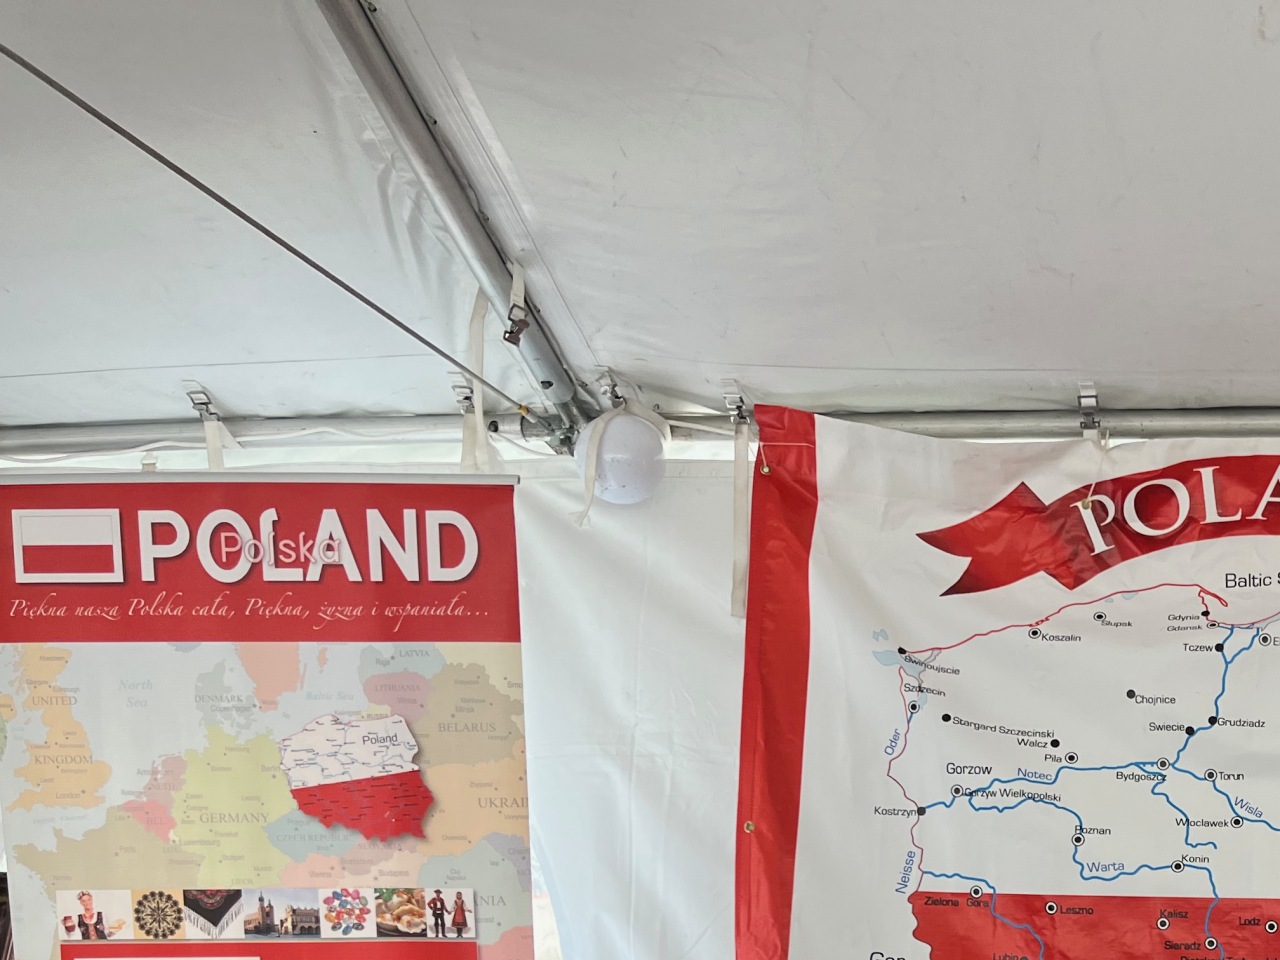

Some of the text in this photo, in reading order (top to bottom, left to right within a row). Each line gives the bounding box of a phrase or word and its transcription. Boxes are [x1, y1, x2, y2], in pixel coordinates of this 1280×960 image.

[138, 508, 480, 583] POLAND
[1225, 573, 1272, 588] Baltic
[1168, 614, 1200, 622] Gdynia
[1042, 633, 1081, 643] Koszalin
[1183, 643, 1213, 653] Tczew
[118, 678, 153, 693] North
[32, 695, 78, 707] UNITED
[1135, 694, 1176, 706] Chojnice
[438, 722, 496, 734] BELARUS
[952, 716, 999, 734] Stargard
[1149, 722, 1185, 732] Swiecie
[1218, 717, 1266, 729] Grudziadz
[362, 731, 398, 746] Poland
[1017, 739, 1048, 748] Walcz
[34, 754, 93, 765] KINGDOM
[1045, 753, 1062, 763] Pila
[947, 763, 992, 776] Gorzow
[1017, 768, 1052, 782] Notec
[1218, 771, 1244, 781] Torun
[874, 806, 916, 817] Kostrzyn
[1234, 796, 1264, 819] Wisla
[199, 812, 269, 824] GERMANY
[1074, 826, 1111, 836] Poznan
[1181, 853, 1210, 863] Konin
[896, 850, 916, 894] Neisse
[1087, 860, 1125, 873] Warta
